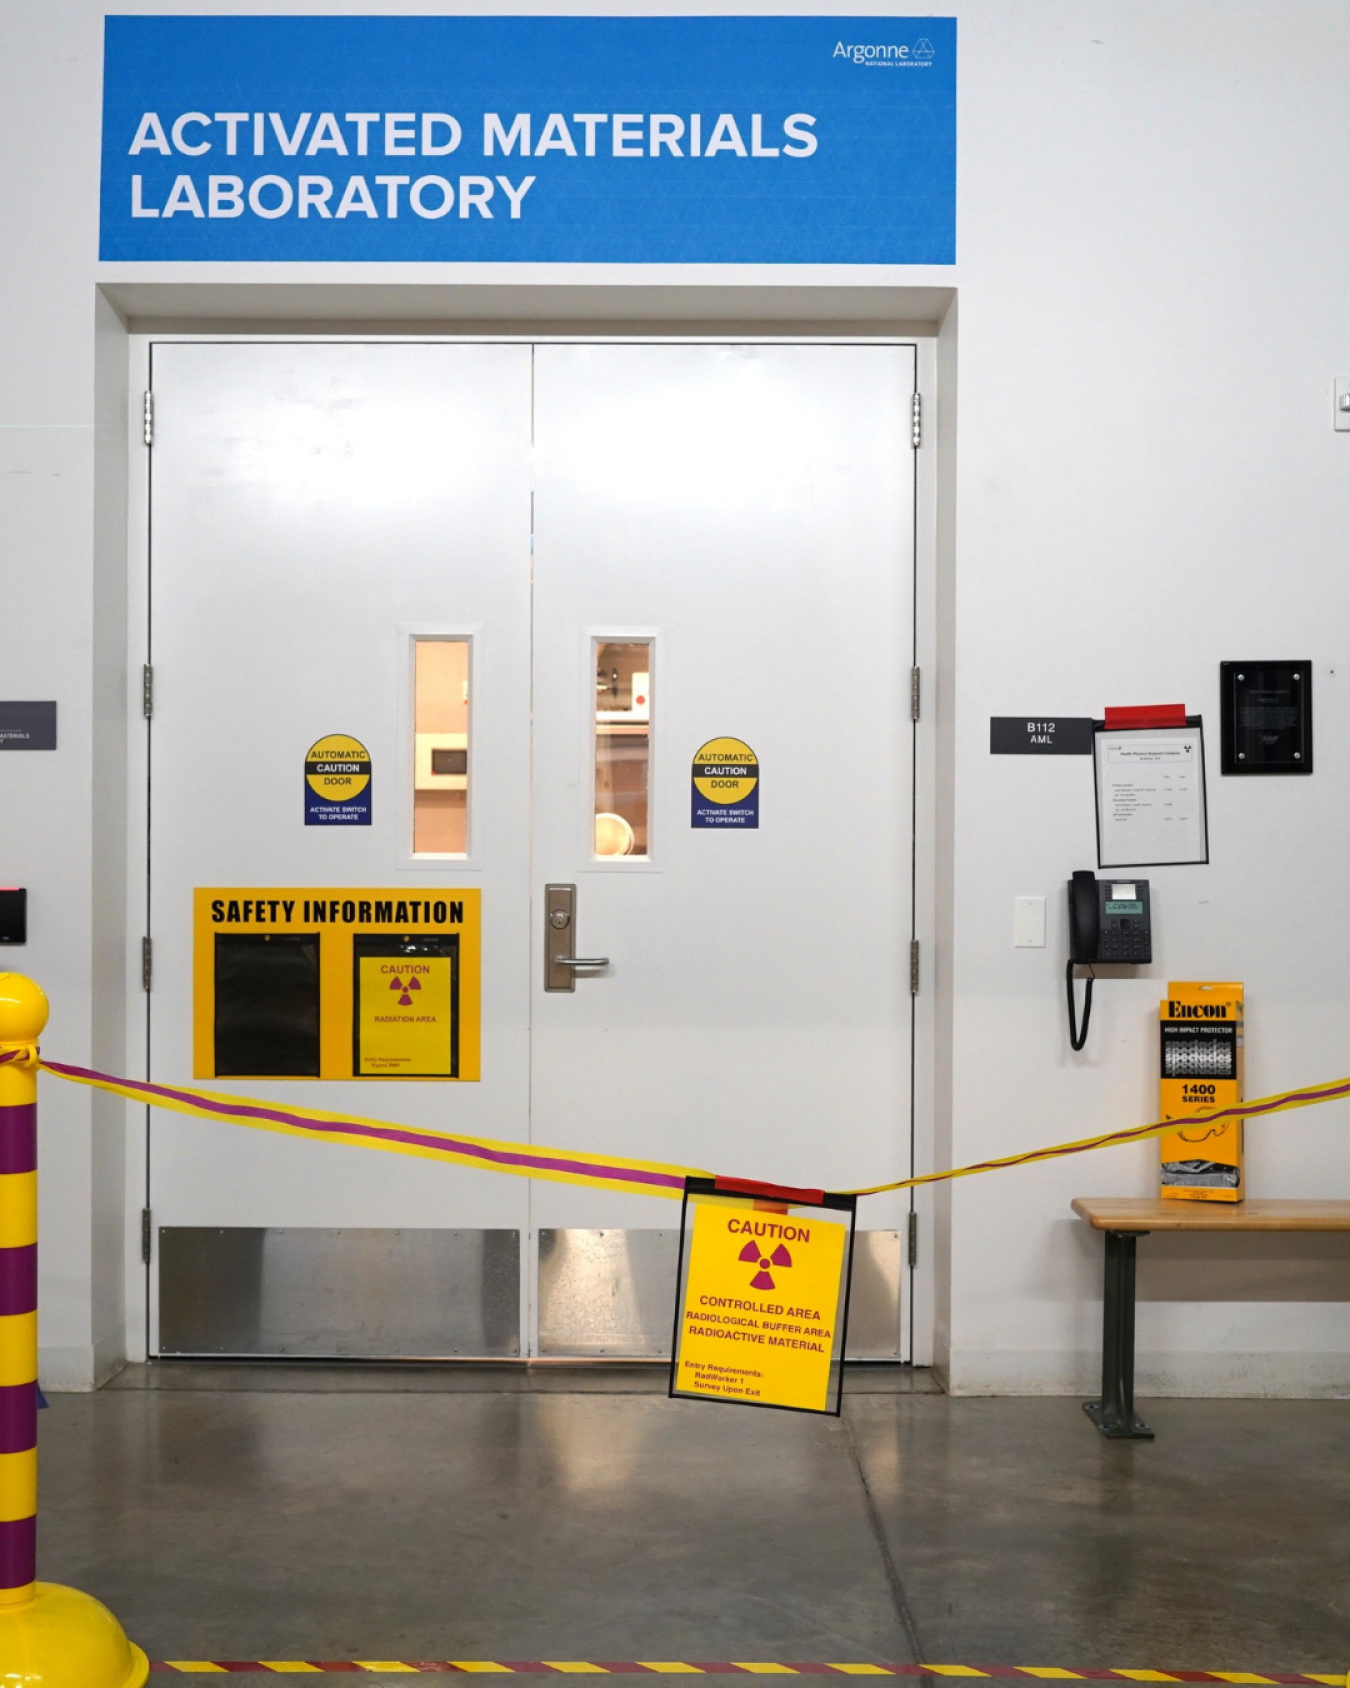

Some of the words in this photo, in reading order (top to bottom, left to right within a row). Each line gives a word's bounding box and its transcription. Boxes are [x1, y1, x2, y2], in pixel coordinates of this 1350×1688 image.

[832, 40, 910, 64] Argonne
[129, 112, 462, 158] ACTIVATED
[483, 112, 818, 159] MATERIALS
[129, 173, 536, 220] LABORATORY
[1027, 722, 1056, 733] B112
[1030, 734, 1053, 744] AML
[311, 750, 366, 759] AUTOMATIC
[698, 753, 754, 762] AUTOMATIC
[316, 763, 360, 773] CAUTION
[704, 766, 747, 775] CAUTION
[324, 777, 352, 785] DOOR
[710, 780, 740, 789] DOOR
[211, 899, 296, 924] SAFETY
[303, 900, 464, 924] INFORMATION
[380, 964, 430, 975] CAUTION
[1168, 1000, 1227, 1018] Encon
[374, 1015, 414, 1023] RADIATION
[415, 1015, 437, 1023] AREA
[1182, 1084, 1216, 1095] 1400
[1182, 1095, 1215, 1103] SERIES
[727, 1218, 811, 1243] CAUTION
[699, 1295, 784, 1316] CONTROLLED
[786, 1307, 821, 1321] AREA
[686, 1311, 760, 1329] RADIOLOGICAL
[762, 1321, 801, 1334] BUFFER
[803, 1326, 831, 1339] AREA
[689, 1326, 766, 1344] RADIOACTIVE
[768, 1335, 825, 1353] MATERIAL
[684, 1360, 706, 1370] Entry
[707, 1363, 764, 1378] Requirements:
[694, 1371, 738, 1384] RadWorker
[694, 1381, 721, 1392] Survey
[723, 1385, 744, 1394] Upon
[745, 1387, 761, 1396] Exit
